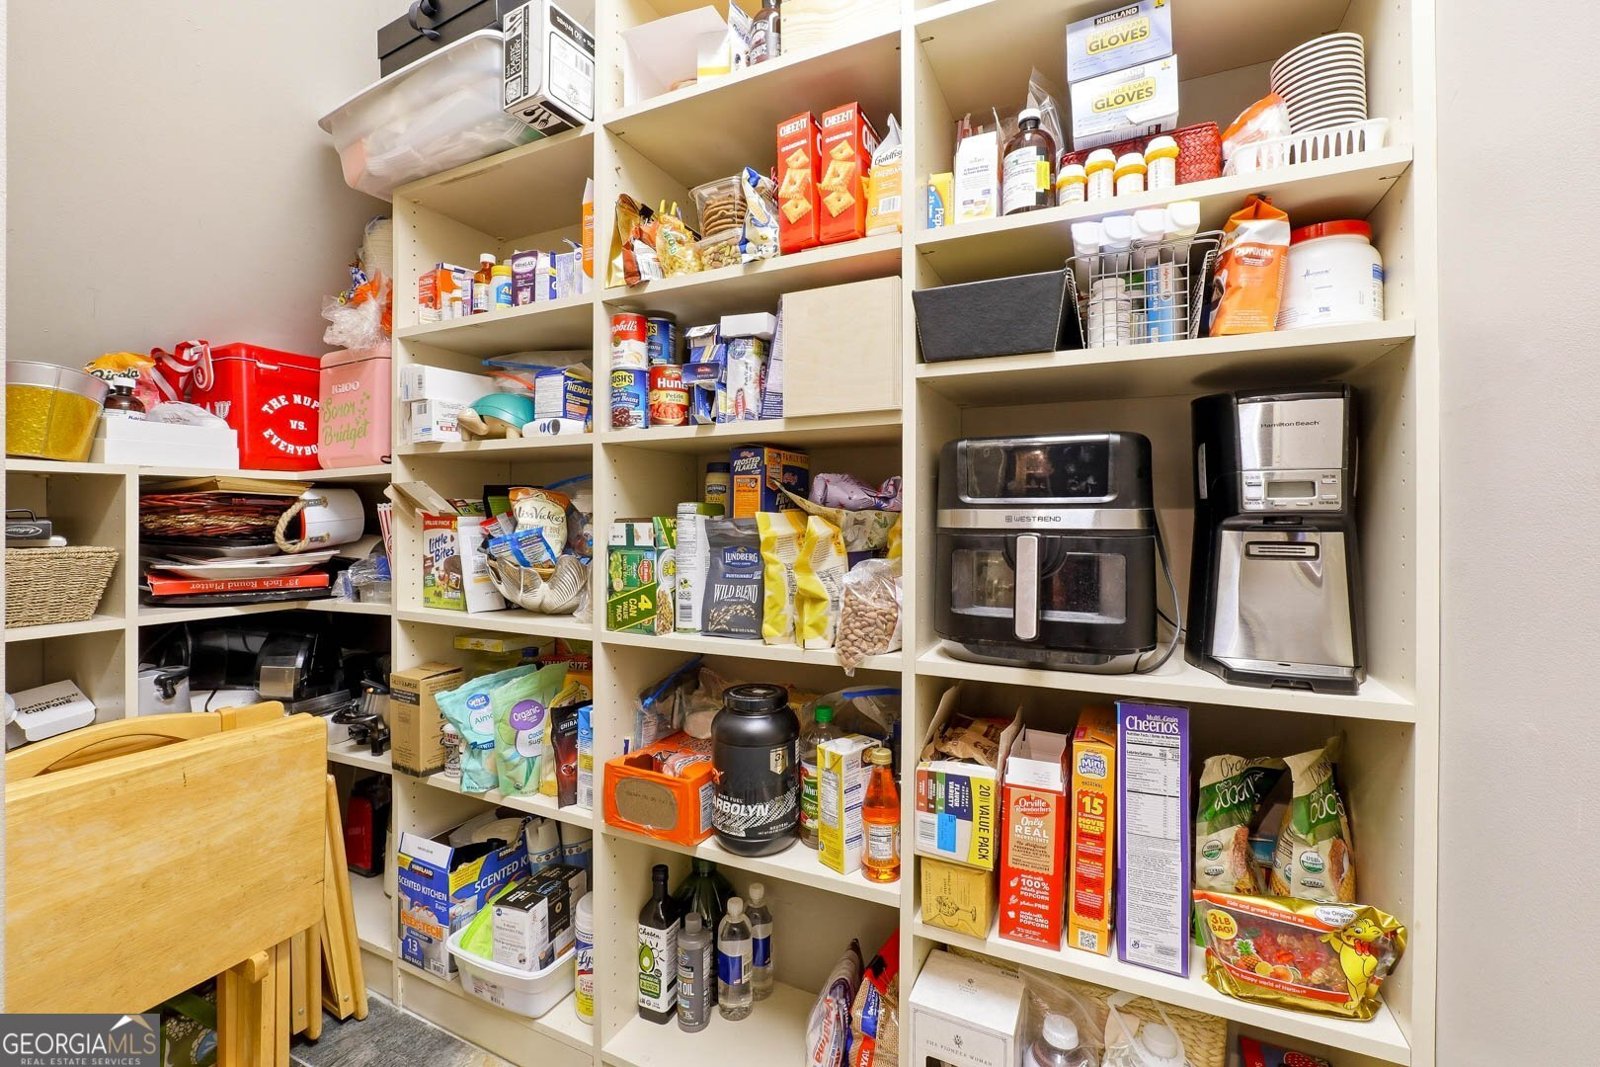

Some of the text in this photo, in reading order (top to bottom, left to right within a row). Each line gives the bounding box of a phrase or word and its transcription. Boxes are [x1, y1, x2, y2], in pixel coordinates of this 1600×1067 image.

[1096, 6, 1138, 25] KIRKLAND
[1088, 26, 1148, 53] GLOVES
[1094, 86, 1153, 111] GLOVES
[824, 109, 853, 128] CHEEZ-IT
[779, 118, 807, 137] CHEEZ-IT
[332, 381, 360, 394] IGLOO
[261, 394, 321, 415] THE NUP
[290, 420, 307, 431] VS.
[322, 420, 370, 449] Bridget
[734, 456, 760, 467] FROSTED
[735, 463, 758, 472] FLAKES
[428, 534, 447, 550] Little
[434, 545, 455, 562] Bites
[725, 552, 758, 563] LUNDBERG
[190, 581, 225, 590] Platter
[228, 580, 258, 590] Round
[263, 579, 284, 588] Inch
[714, 584, 758, 604] WILD BLEND
[629, 597, 638, 617] CAN
[639, 594, 653, 610] 4
[513, 706, 540, 722] Organic
[1126, 715, 1179, 734] Cheerios
[1082, 759, 1104, 769] Mini
[1019, 798, 1047, 808] Orville
[1082, 795, 1104, 816] 15
[977, 784, 990, 860] 20 VALUE PACK
[1021, 817, 1044, 828] Only
[1015, 825, 1049, 838] REAL
[474, 861, 519, 894] SCENTED
[398, 875, 447, 901] SCENTED KITCHEN
[1021, 878, 1049, 891] 100%
[1020, 890, 1049, 901] POPCORN
[1034, 902, 1049, 910] FREE
[1020, 914, 1049, 924] NON-GMO
[1020, 919, 1049, 929] POPCORN
[1210, 913, 1231, 926] 3 LB
[639, 928, 661, 939] Chosen
[407, 938, 418, 951] 13
[941, 1045, 967, 1057] PIONEER
[969, 1054, 993, 1066] WOMAN
